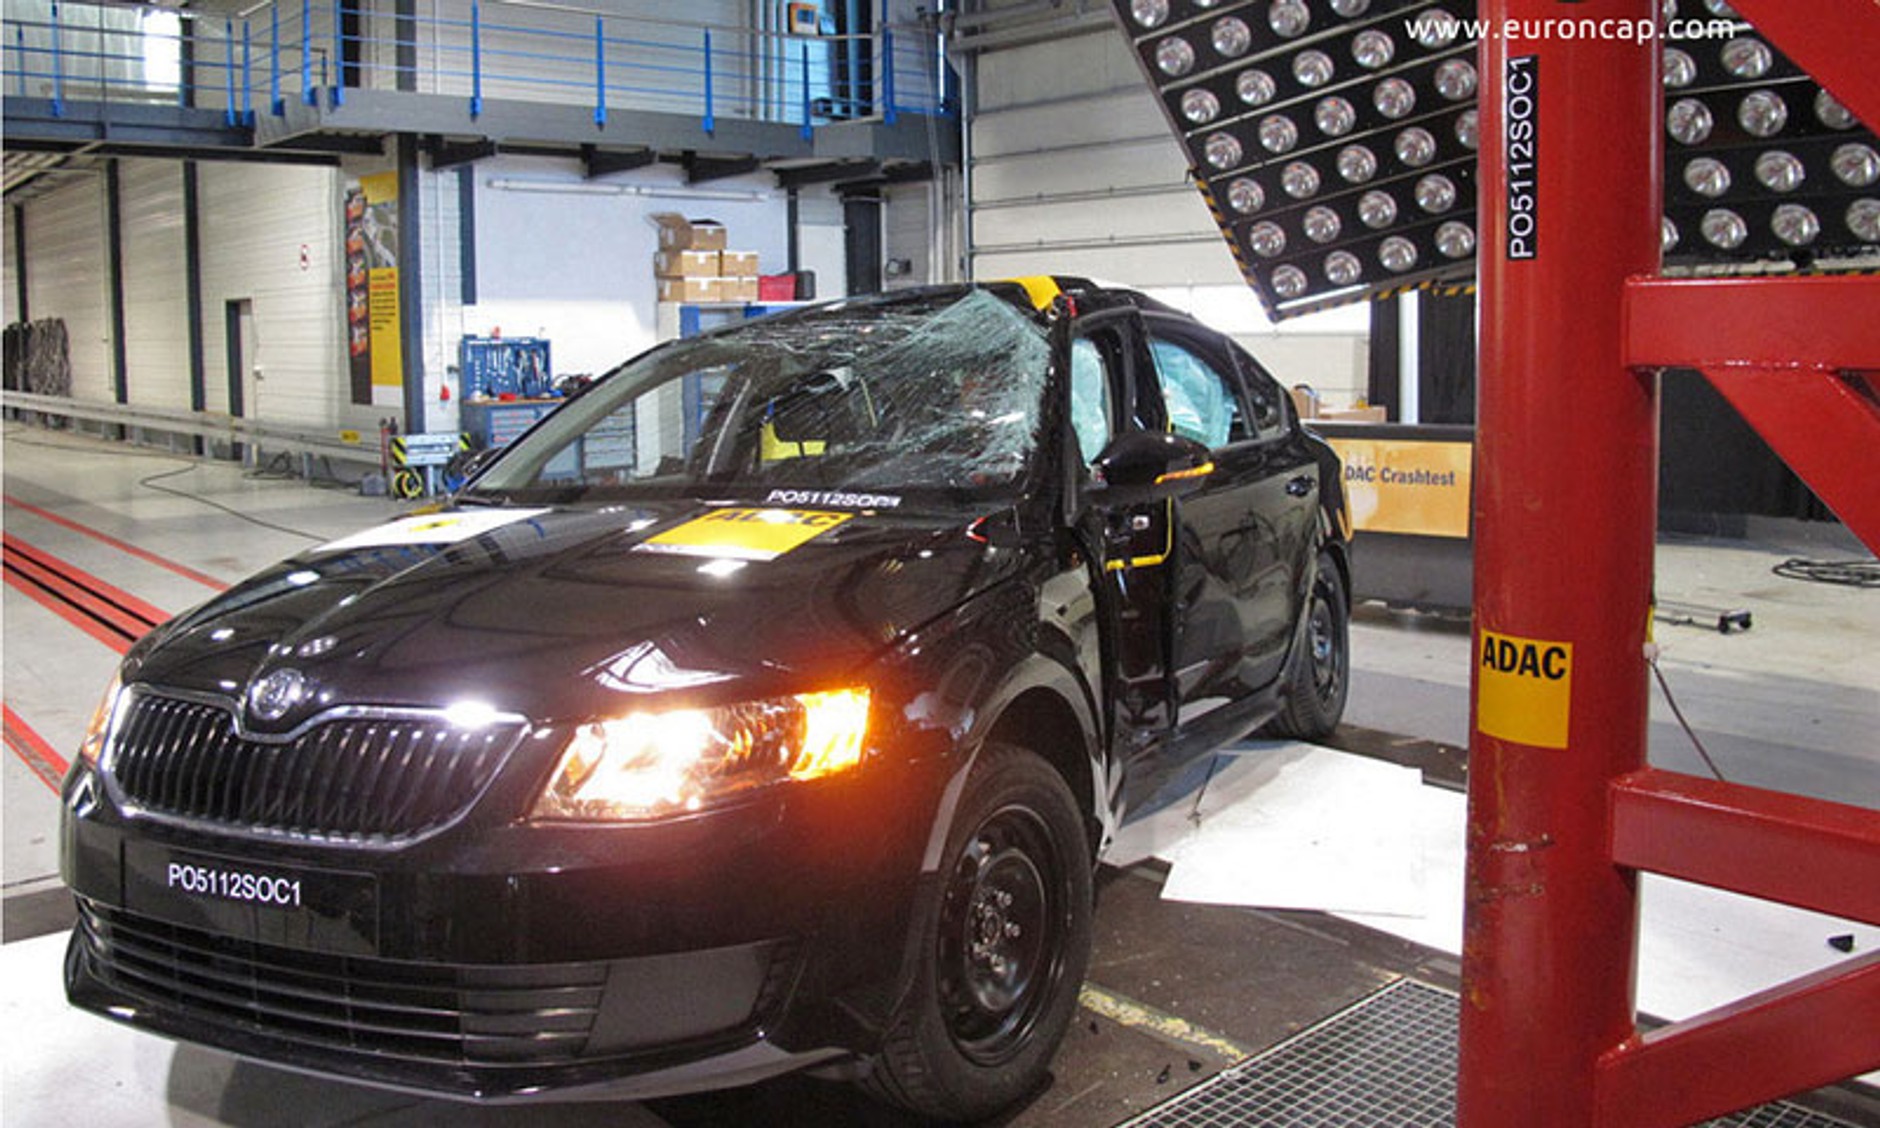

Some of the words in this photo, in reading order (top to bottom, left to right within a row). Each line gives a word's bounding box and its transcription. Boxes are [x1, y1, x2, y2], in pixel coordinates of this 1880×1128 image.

[1508, 56, 1534, 258] PO5112SOC1
[1344, 464, 1376, 483] DAC
[1380, 467, 1456, 486] Crashtest
[1482, 636, 1567, 680] ADAC
[168, 862, 300, 906] PO5112SOC1
